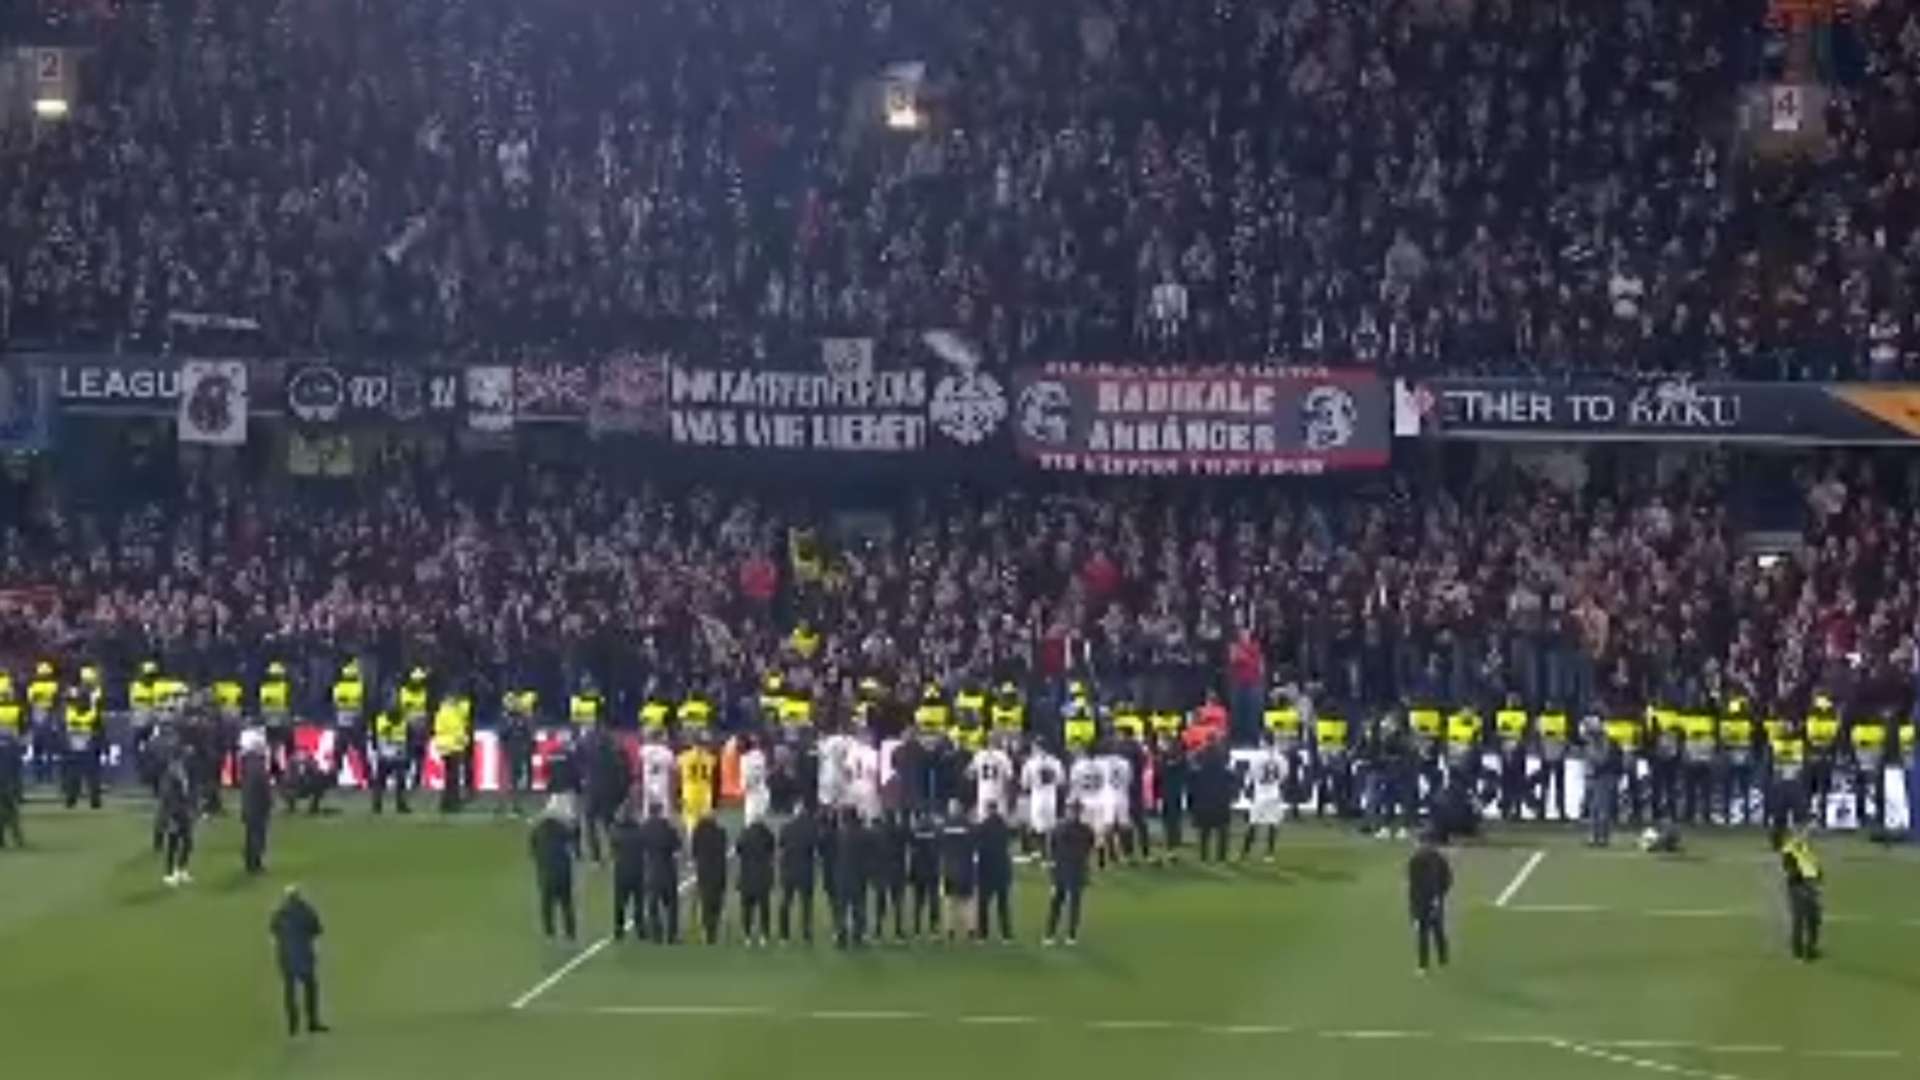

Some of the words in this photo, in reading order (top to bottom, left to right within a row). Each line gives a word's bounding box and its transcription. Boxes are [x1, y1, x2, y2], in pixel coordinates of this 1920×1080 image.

[42, 53, 58, 77] 2
[1777, 89, 1799, 116] 4
[1098, 380, 1277, 415] RADIKALE
[1565, 395, 1615, 422] TO
